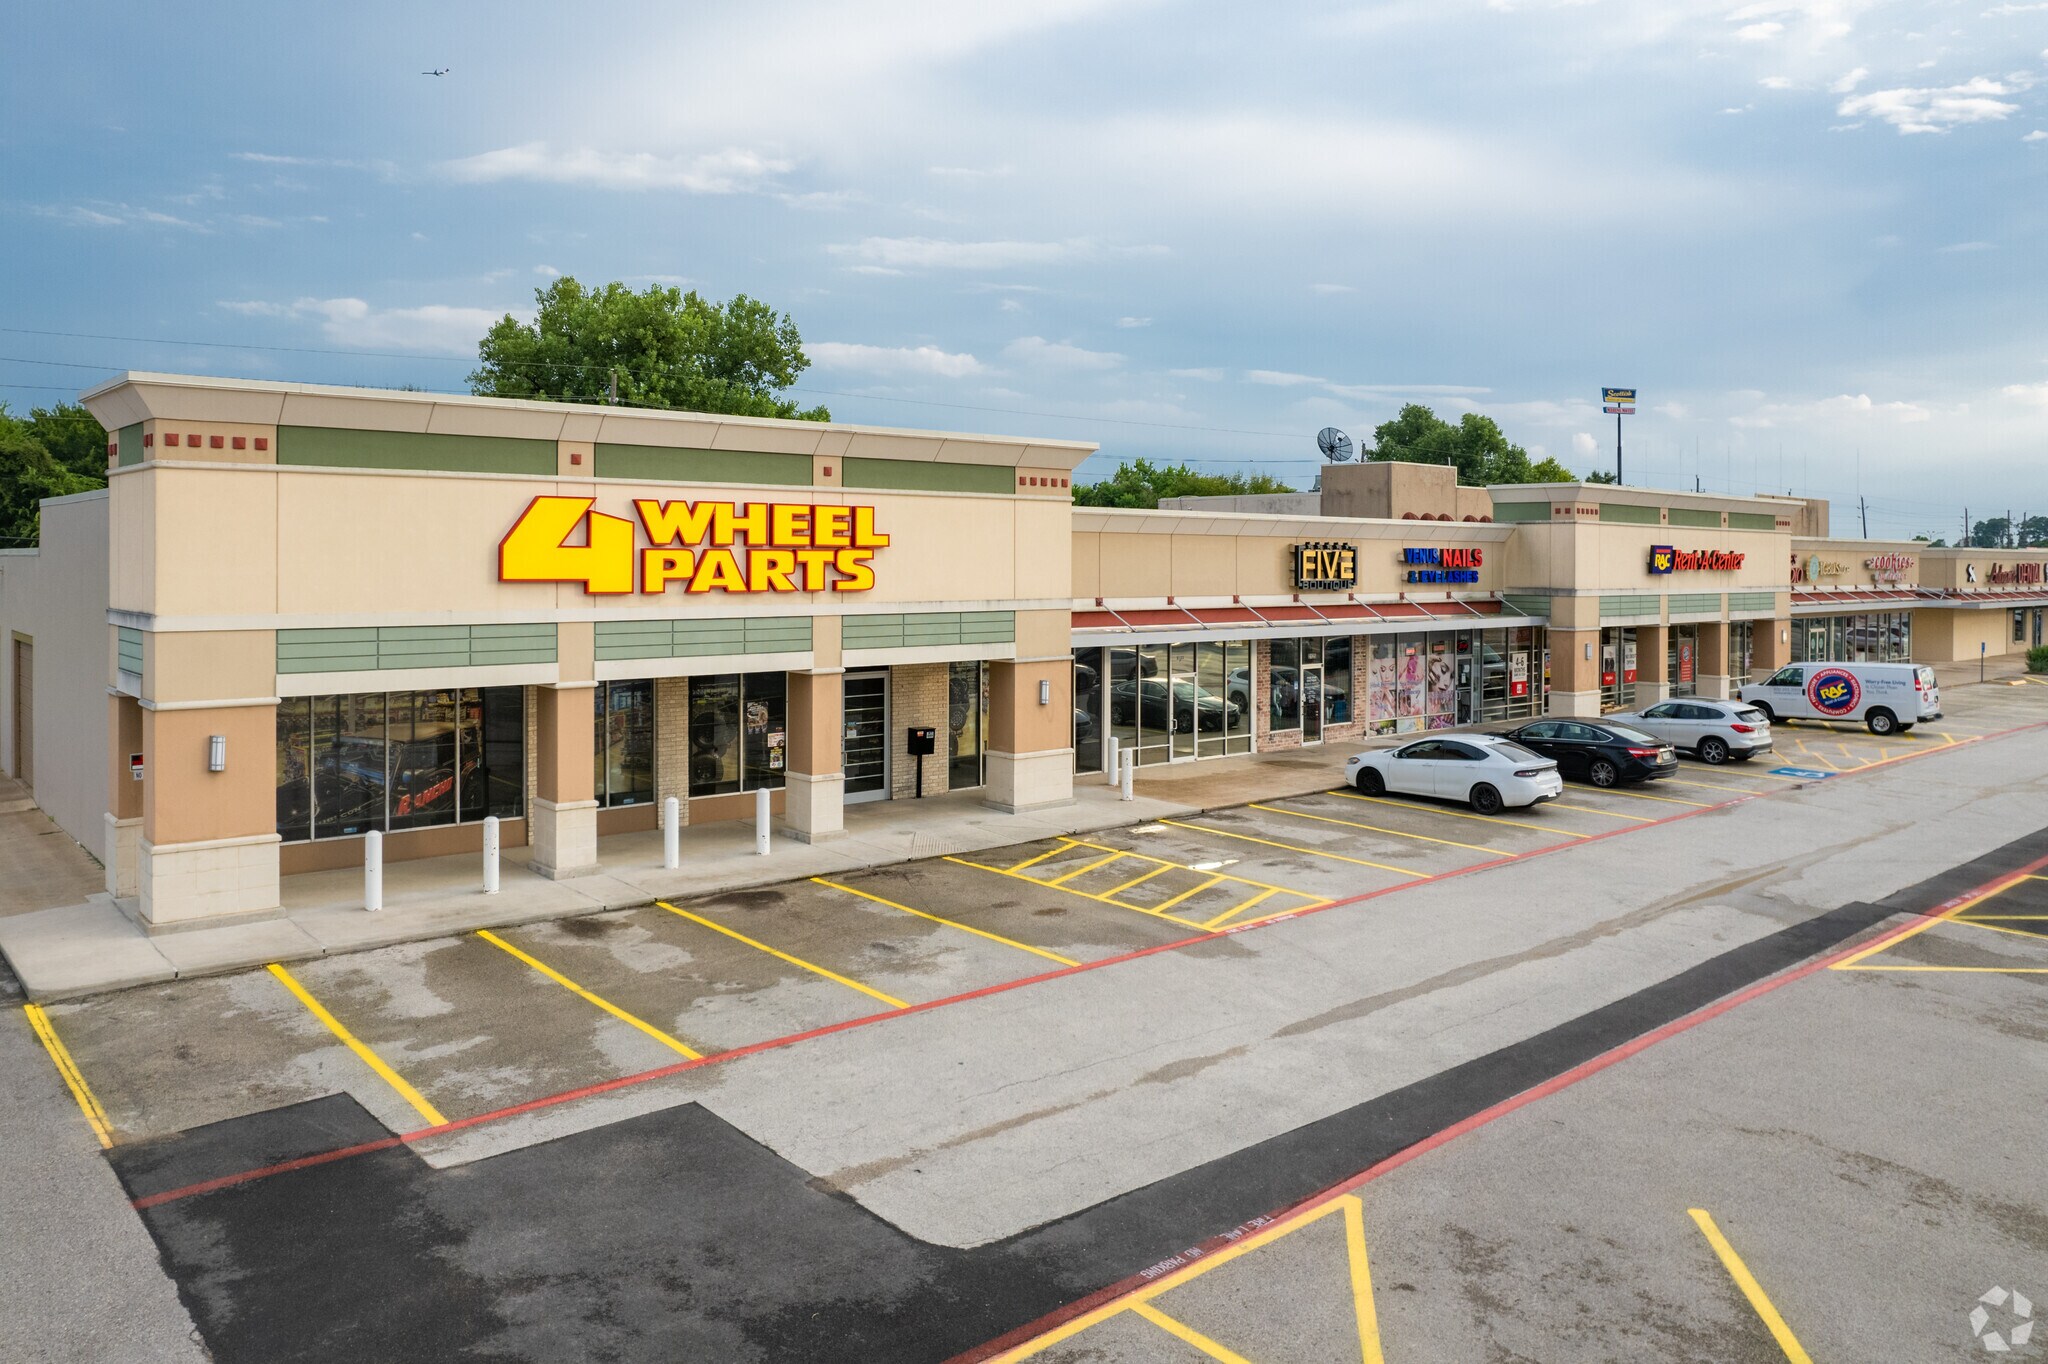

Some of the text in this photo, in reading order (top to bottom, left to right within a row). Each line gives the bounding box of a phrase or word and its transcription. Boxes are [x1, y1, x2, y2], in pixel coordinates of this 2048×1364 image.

[633, 498, 890, 548] WHEEL
[498, 495, 635, 594] 4
[1303, 550, 1354, 579] FIVE
[1404, 547, 1483, 567] VENUS NAILS
[1654, 553, 1671, 571] RAC
[640, 548, 875, 594] PARTS
[1409, 570, 1479, 583] & EYELASHES
[1301, 580, 1354, 591] BOUTIQUE
[1820, 682, 1848, 700] RAC
[1219, 1225, 1249, 1241] LANE
[1140, 1256, 1186, 1279] PARKING
